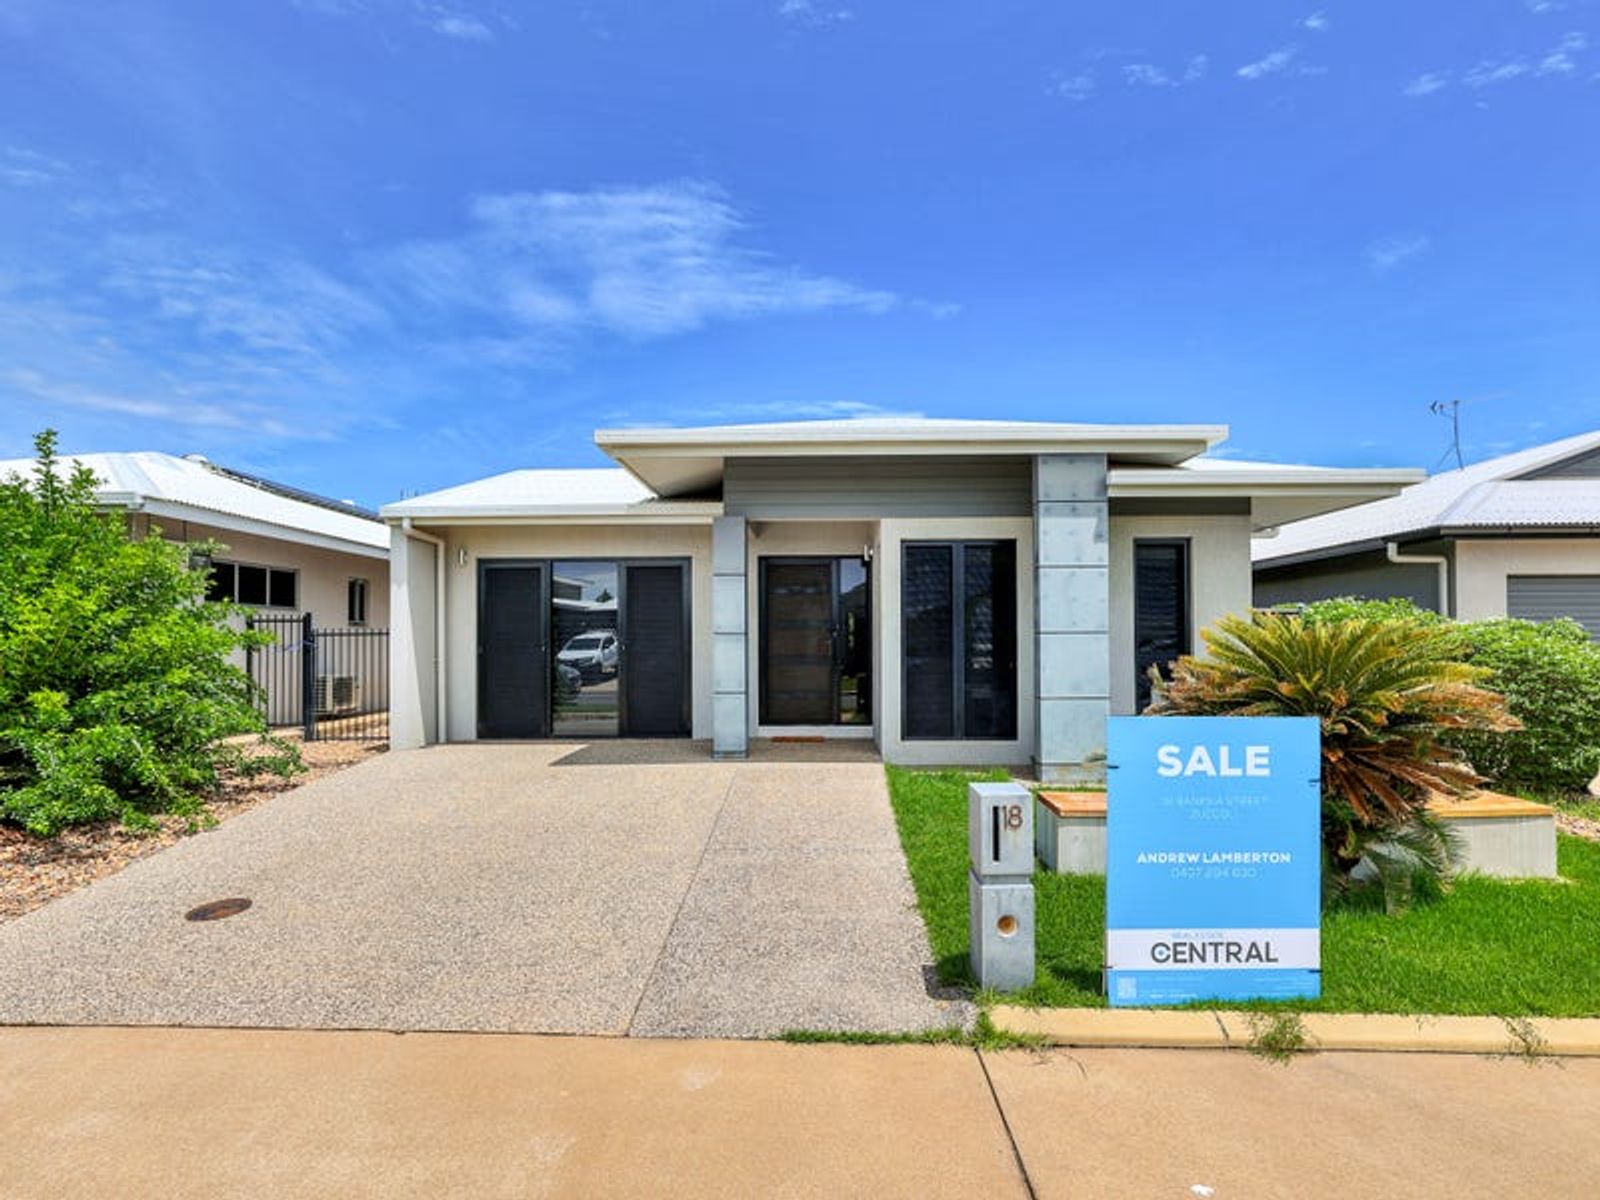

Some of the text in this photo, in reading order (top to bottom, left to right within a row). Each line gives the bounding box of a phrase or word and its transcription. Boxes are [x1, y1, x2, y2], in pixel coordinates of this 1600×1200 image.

[1156, 744, 1270, 777] SALE
[1001, 805, 1023, 831] 18
[1136, 852, 1291, 864] ANDREW LAMBERTON
[1150, 941, 1278, 964] CENTRAL
